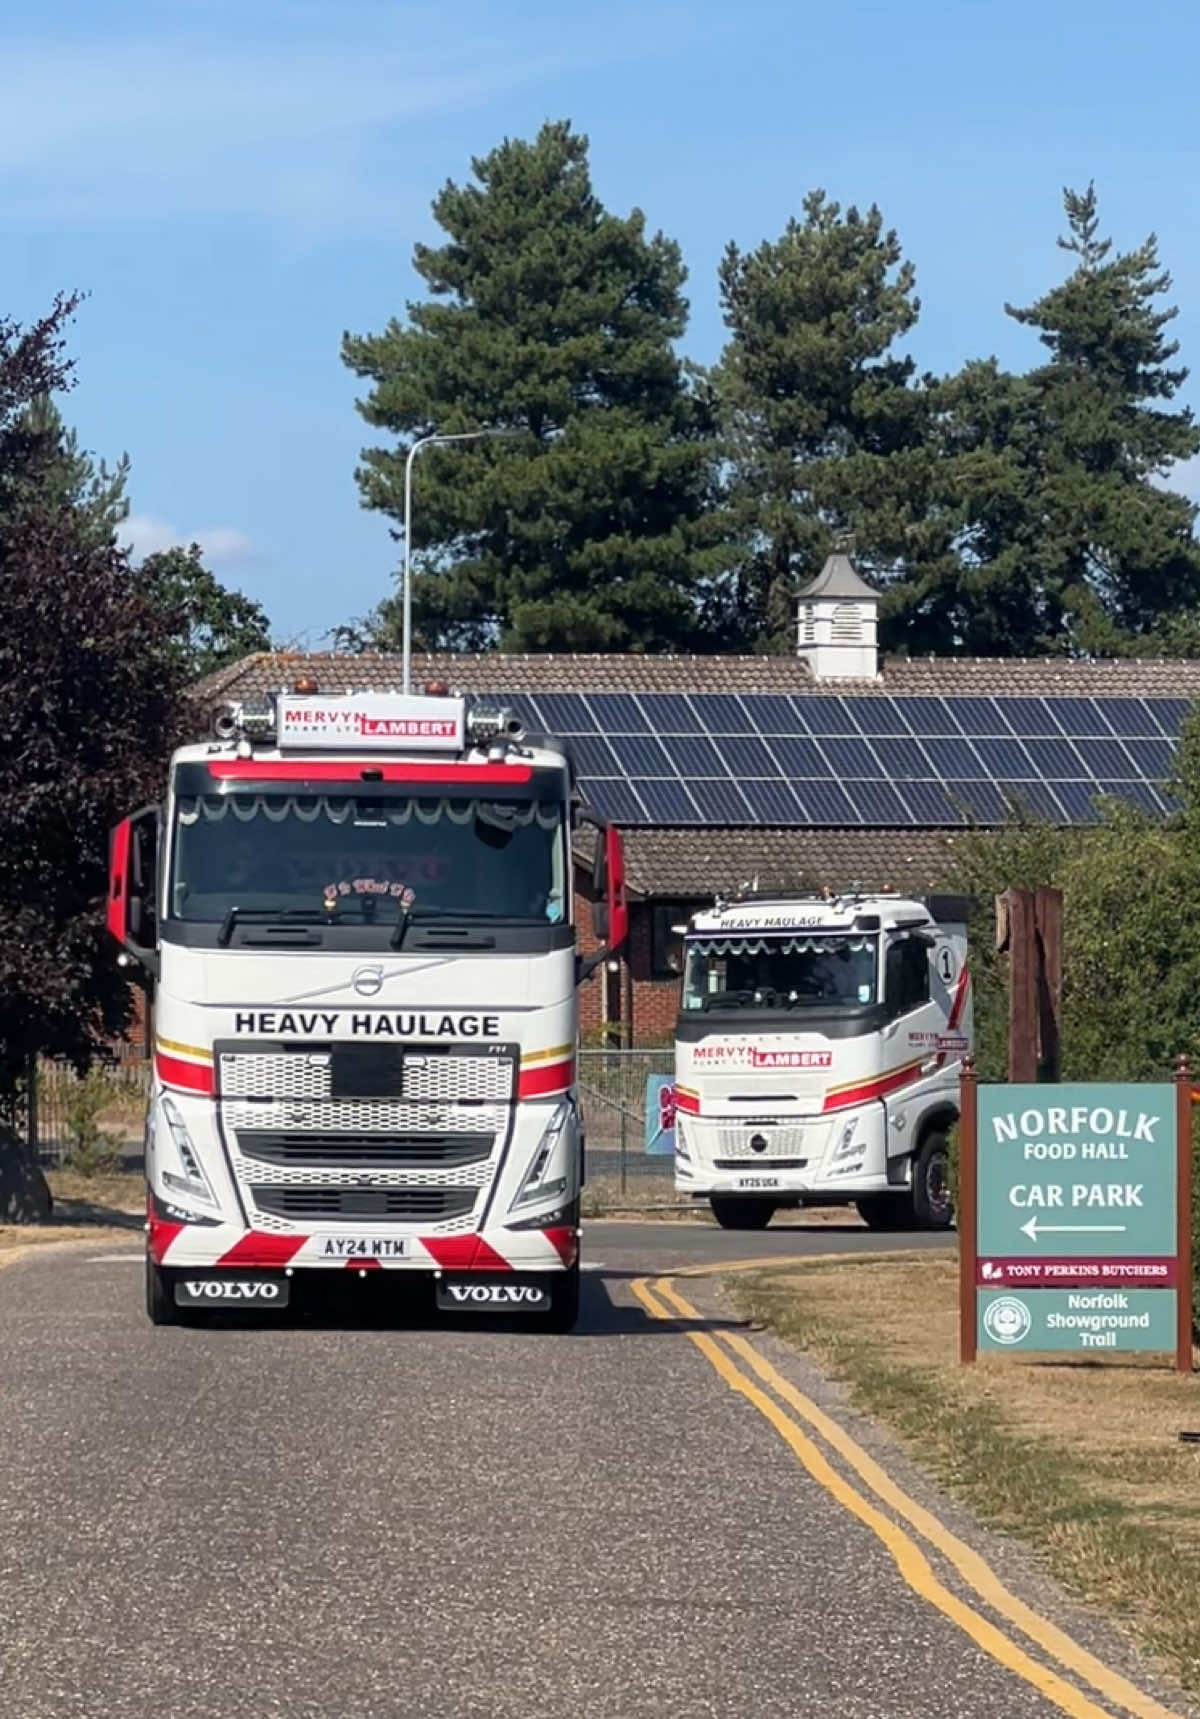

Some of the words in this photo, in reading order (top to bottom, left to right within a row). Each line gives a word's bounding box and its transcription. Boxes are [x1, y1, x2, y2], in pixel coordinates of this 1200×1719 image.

[285, 710, 367, 723] MERVYN
[364, 721, 455, 735] LAMBERT
[721, 919, 761, 928] HEAVY
[764, 916, 823, 927] HAULAGE
[235, 1013, 340, 1033] HEAVY
[351, 1014, 500, 1036] HAULAGE
[693, 1046, 758, 1058] MERVYN
[755, 1052, 831, 1066] LAMBERT
[992, 1107, 1160, 1143] NORFOLK
[1024, 1143, 1076, 1160] FOOD
[1081, 1143, 1129, 1160] HALL
[1009, 1184, 1064, 1208] CAR
[1071, 1184, 1144, 1208] PARK
[324, 1239, 367, 1256] AY24
[1007, 1265, 1041, 1277] TONY
[1044, 1265, 1099, 1277] PERKINS
[1102, 1265, 1168, 1277] BUTCHERS
[184, 1281, 280, 1299] VOLVO
[447, 1285, 544, 1303] VOLVO
[1068, 1294, 1128, 1309] Norfolk
[1047, 1312, 1150, 1330] Showground
[1079, 1331, 1117, 1346] Trail
